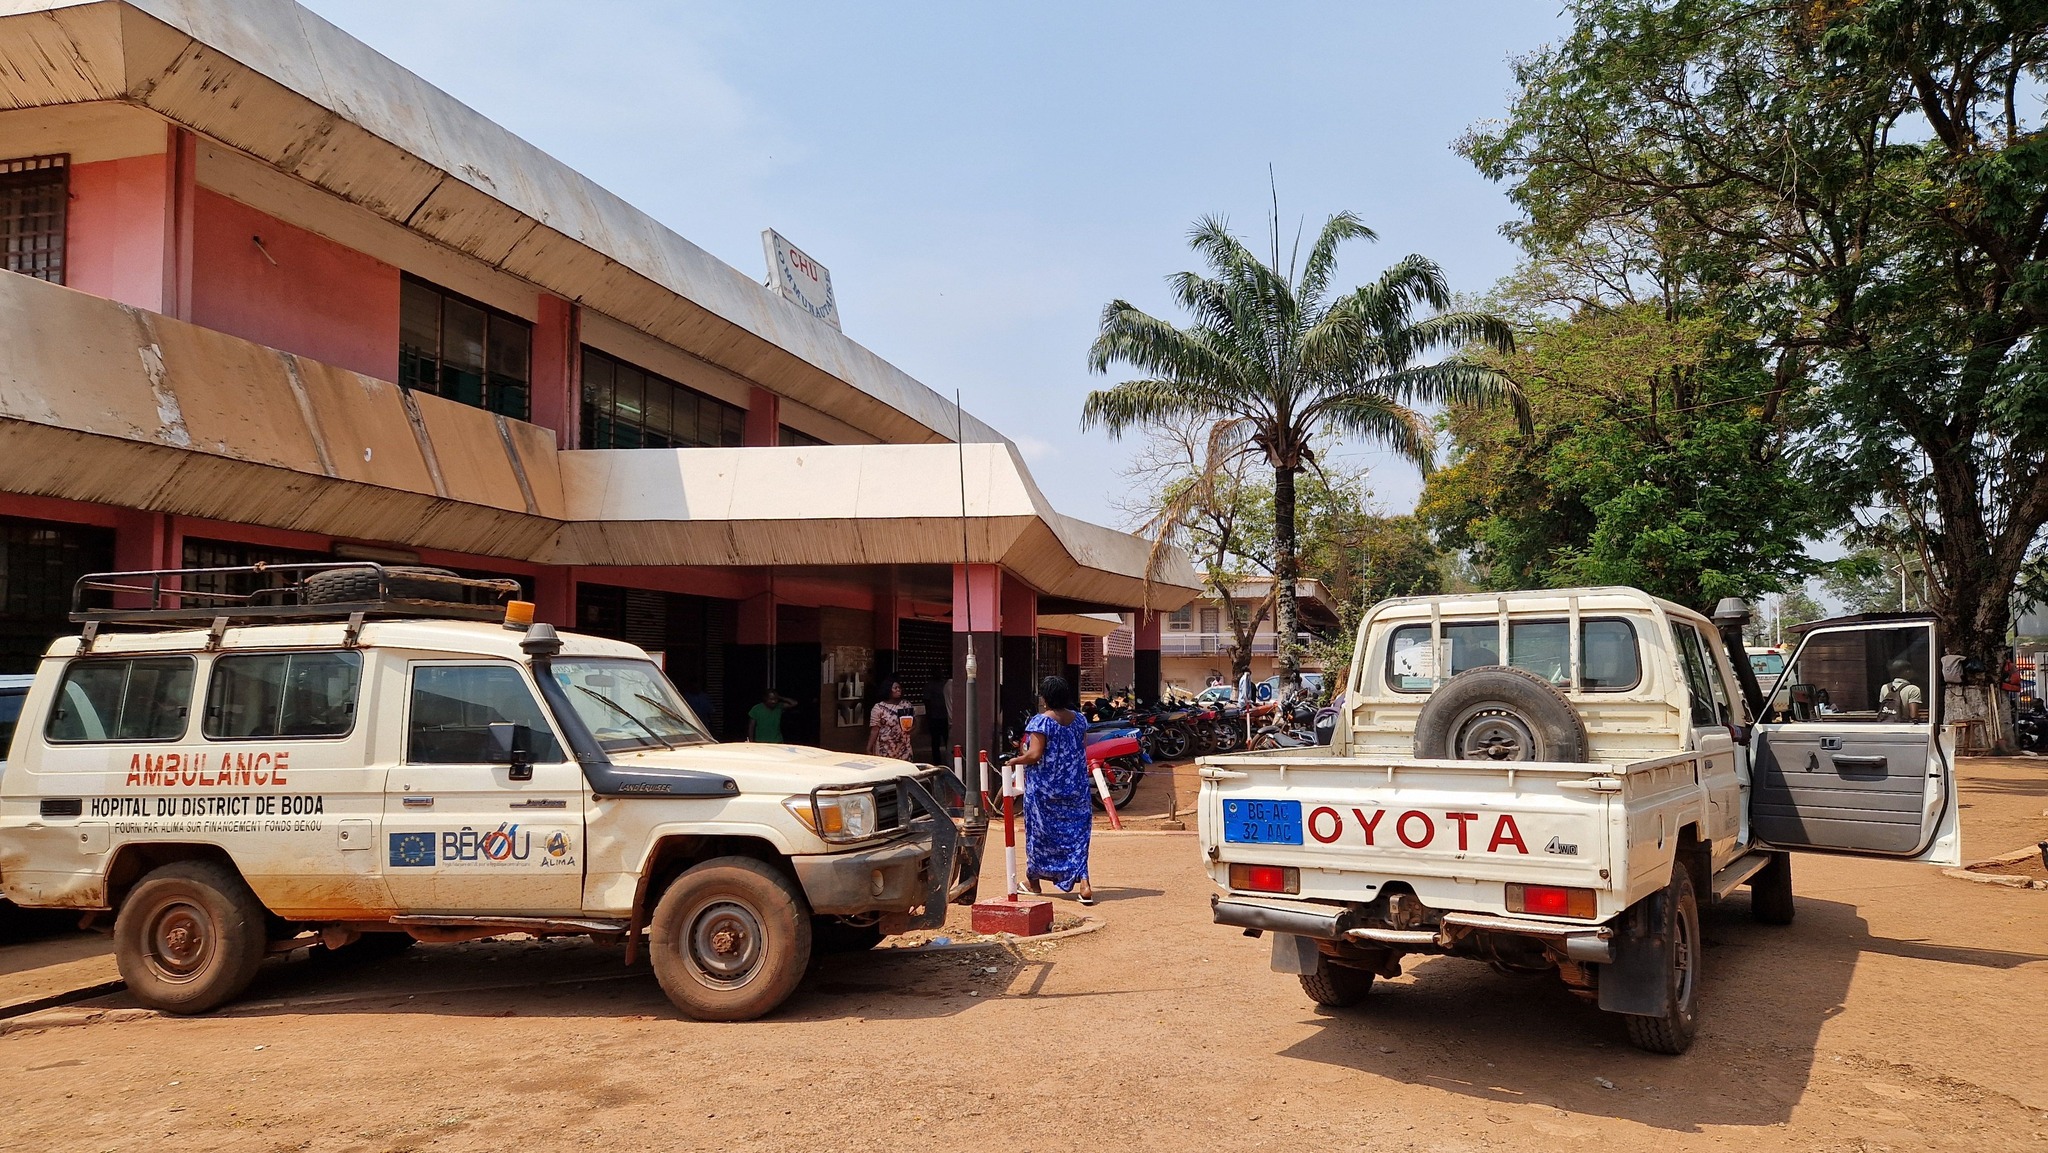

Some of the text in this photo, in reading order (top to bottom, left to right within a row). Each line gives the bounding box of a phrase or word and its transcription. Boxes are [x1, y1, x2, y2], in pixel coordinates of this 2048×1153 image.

[789, 248, 818, 282] CHU
[774, 234, 834, 319] COMMUNAUTAIRE
[126, 752, 290, 787] AMBULANCE
[91, 795, 324, 818] HOPITAL DU DISTRICT DE BODA
[1248, 802, 1289, 821] BG-AC
[114, 820, 322, 834] FOURNI PAR ALIMA SUR FINANCEMENT FONDS BEKOU
[1243, 822, 1291, 841] 32 AAC
[1308, 806, 1529, 855] OYOTA
[1544, 836, 1578, 856] 4WD
[539, 856, 576, 868] ALIMA
